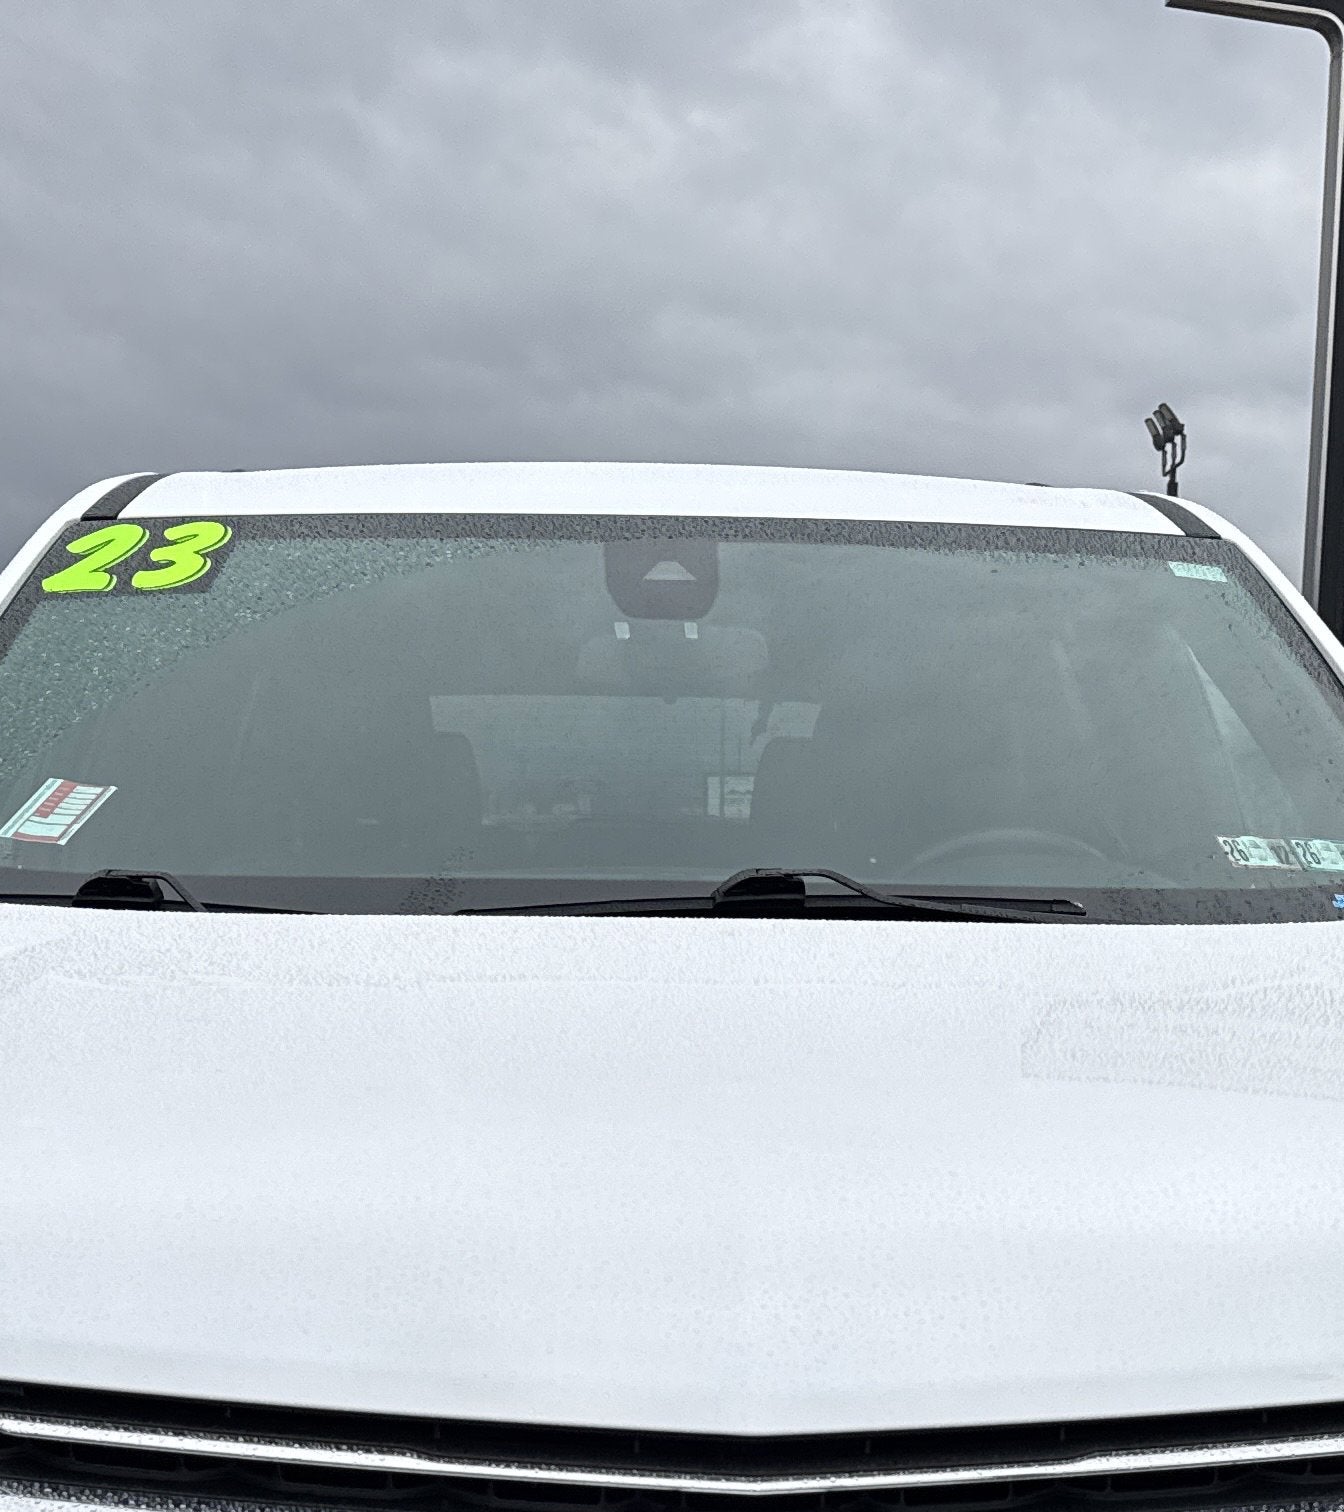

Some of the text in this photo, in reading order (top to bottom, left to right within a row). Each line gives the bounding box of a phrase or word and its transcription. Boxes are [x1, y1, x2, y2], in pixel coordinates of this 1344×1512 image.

[42, 521, 232, 593] 23
[1222, 839, 1250, 862] 26
[1295, 841, 1322, 865] 26
